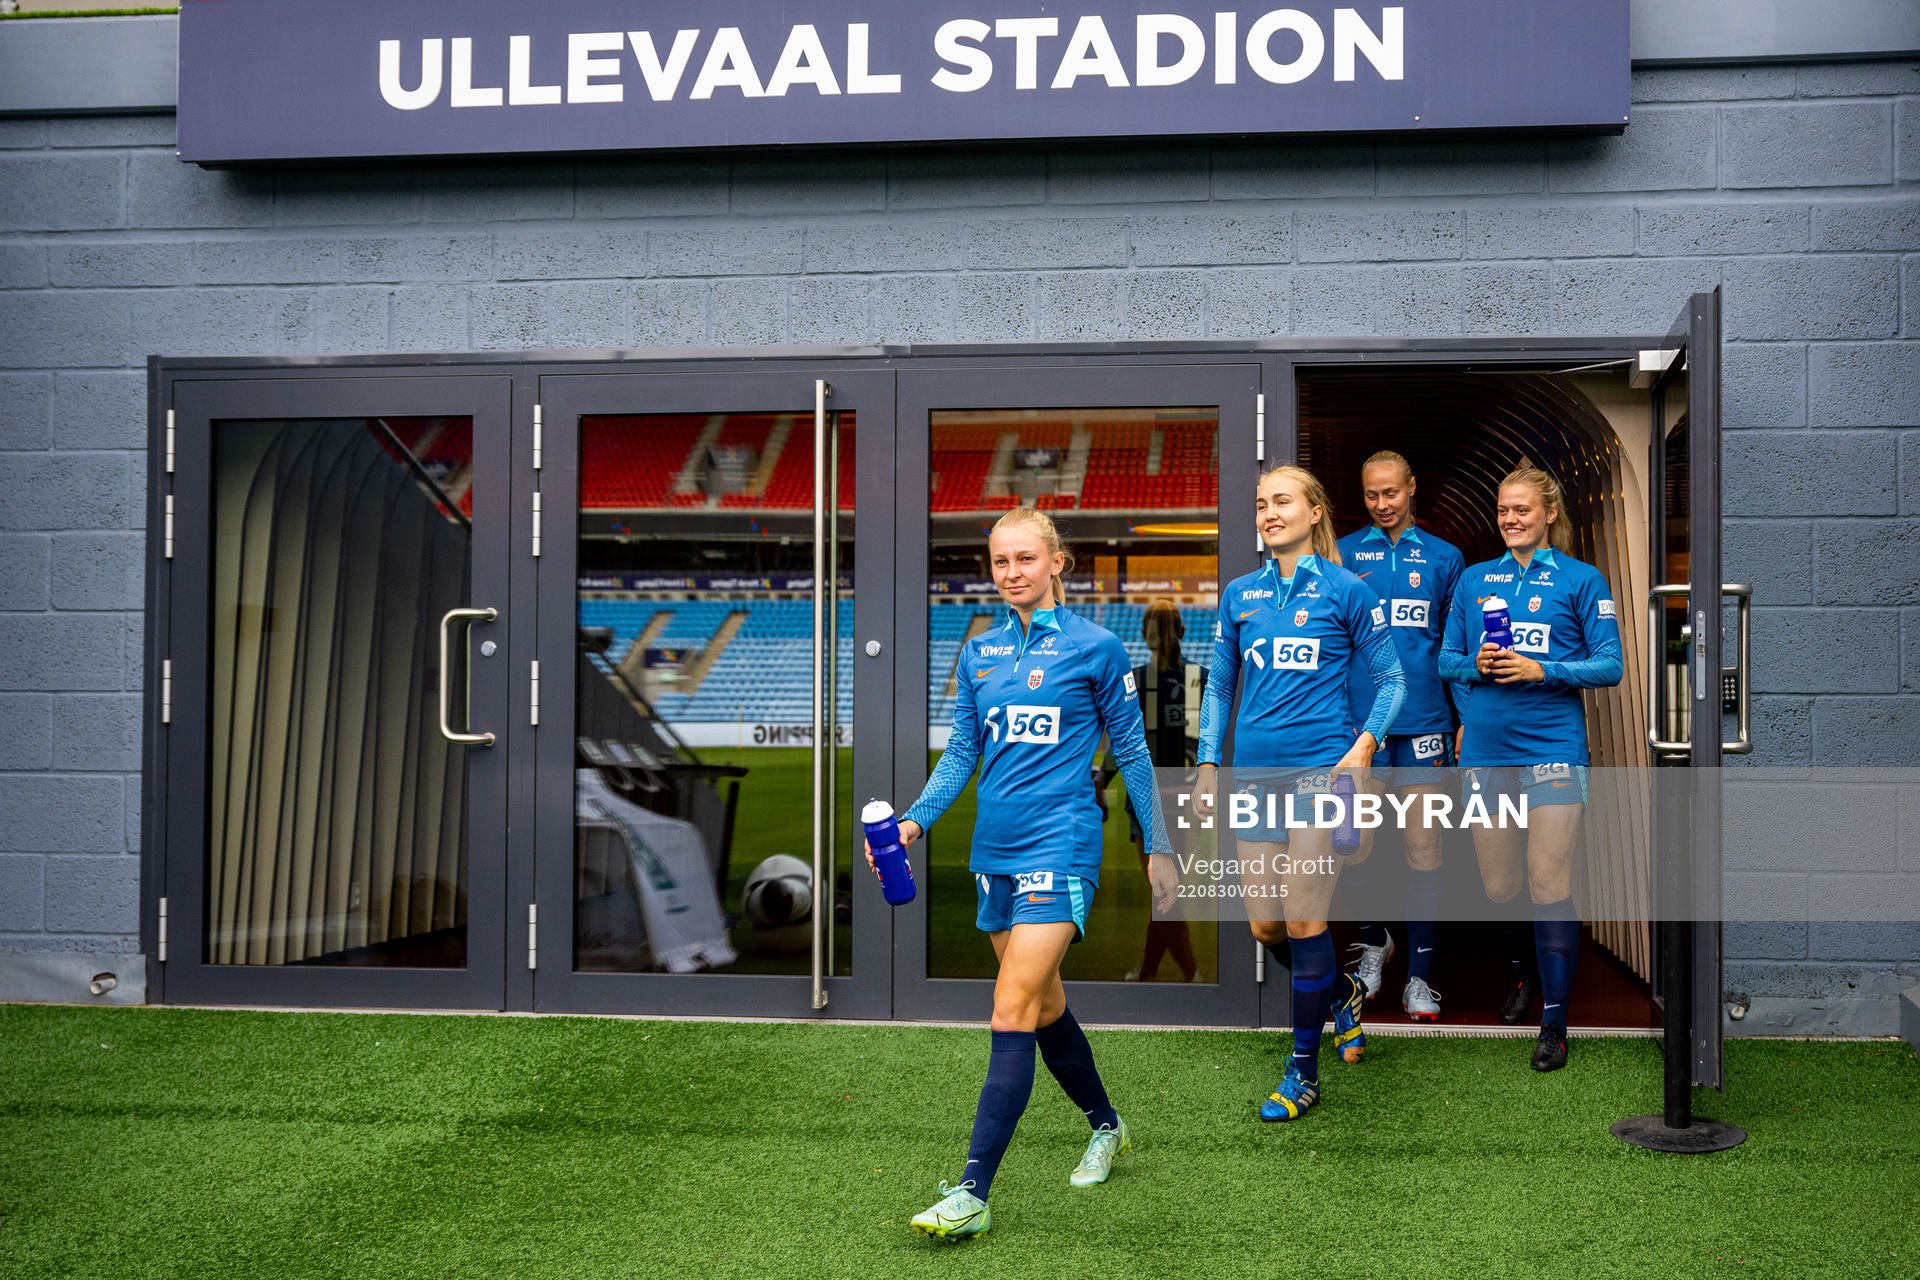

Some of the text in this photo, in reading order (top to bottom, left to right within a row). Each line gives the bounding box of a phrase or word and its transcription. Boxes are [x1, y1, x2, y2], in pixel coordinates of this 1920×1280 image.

[378, 6, 1404, 110] ULLEVAAL STADION
[1355, 551, 1375, 561] KIWI
[1484, 574, 1504, 582] KIWI
[1243, 589, 1263, 600] KIWI
[1395, 605, 1425, 621] 5G
[1512, 628, 1544, 647] 5G
[981, 645, 1003, 658] KIWI
[1278, 644, 1313, 664] 5G
[1012, 713, 1053, 737] 5G
[1418, 738, 1441, 754] 5G
[1538, 763, 1564, 777] 5G
[1301, 774, 1329, 789] 5G
[1020, 871, 1047, 888] 5G
